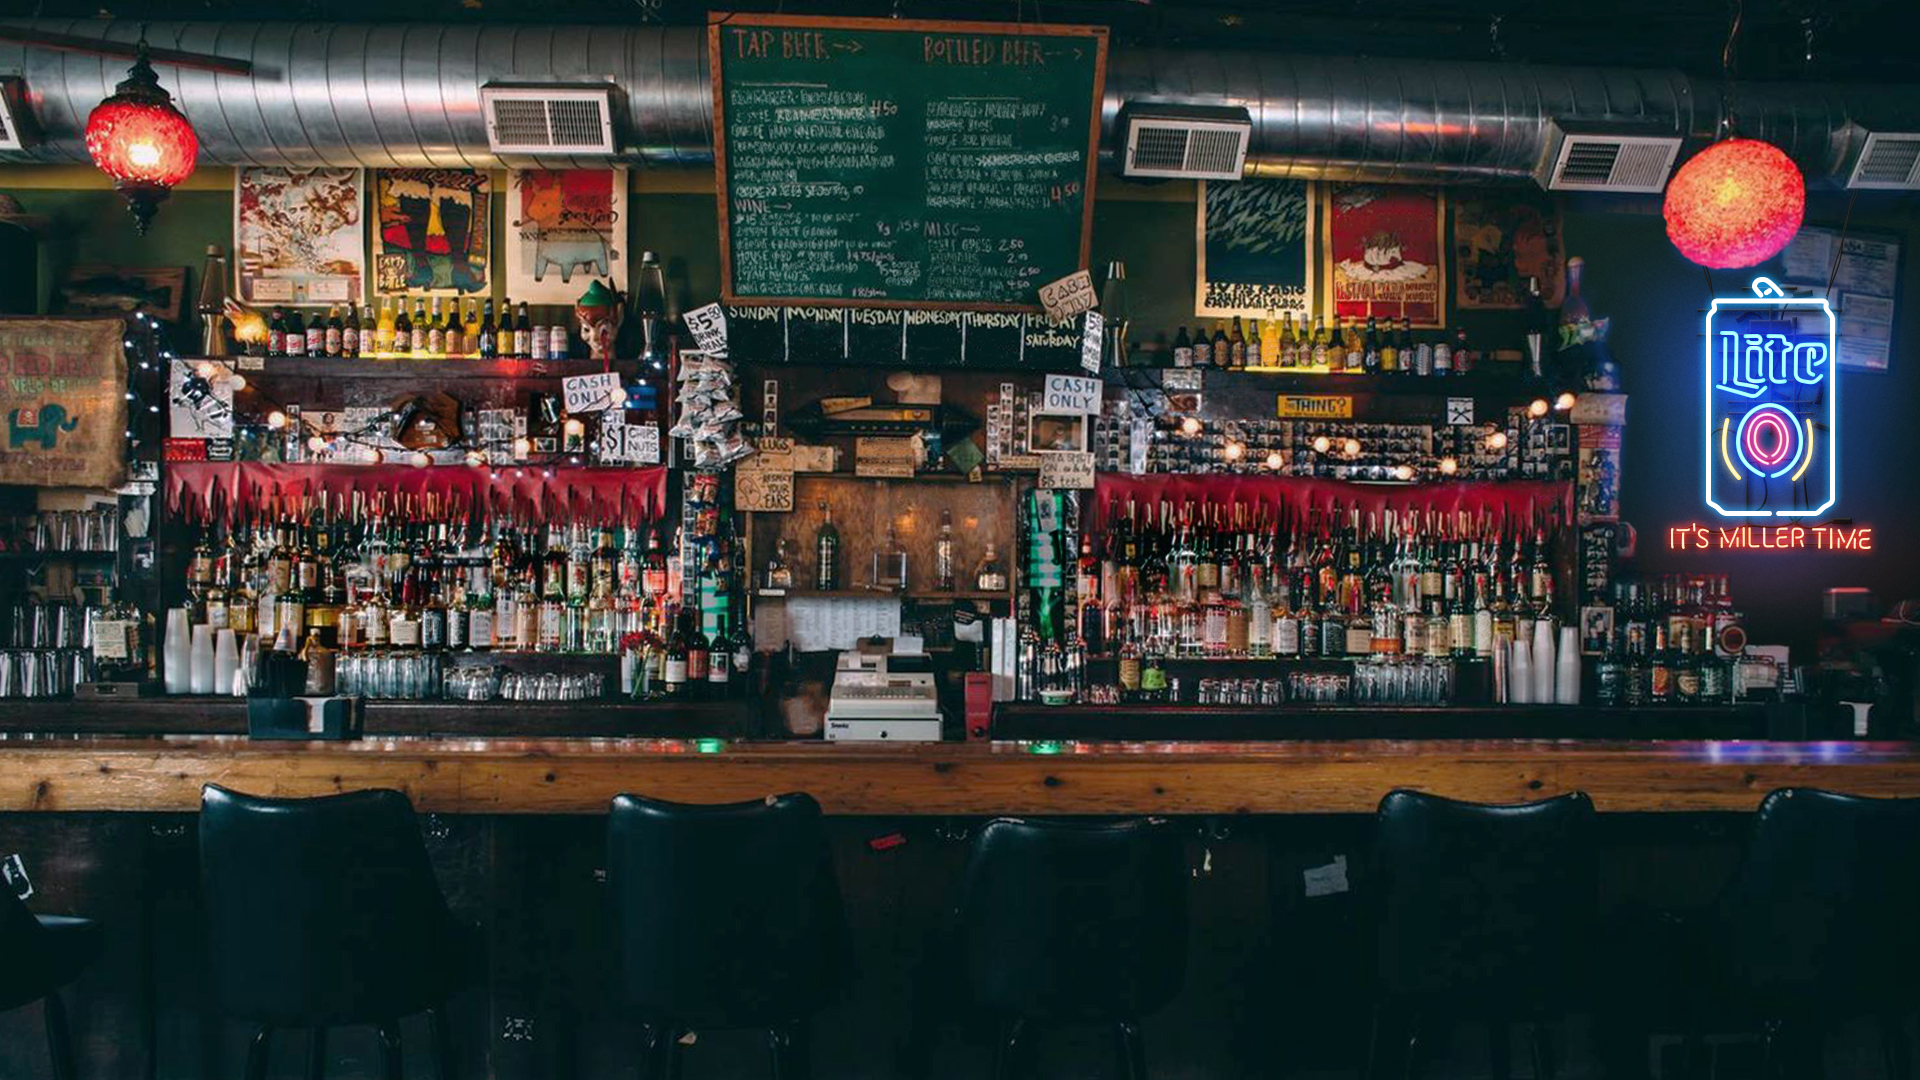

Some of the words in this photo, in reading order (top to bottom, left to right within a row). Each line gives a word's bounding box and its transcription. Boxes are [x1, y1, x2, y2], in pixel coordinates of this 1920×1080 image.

[733, 29, 774, 59] TAP
[782, 31, 829, 60] BEER
[923, 35, 991, 64] BOTTLED
[734, 199, 771, 214] WINE
[923, 220, 960, 237] MISC
[729, 305, 781, 324] SUNDAY
[787, 305, 844, 325] MONDAY
[850, 307, 902, 326] TUESDAY
[907, 310, 961, 328] WEDNESDAY
[965, 310, 1021, 329] THURSDAY
[694, 326, 722, 343] DRINK
[1025, 333, 1080, 349] SATURDAY
[700, 336, 728, 351] DEALS
[1716, 330, 1828, 399] Lite
[566, 374, 611, 391] CASH
[1051, 378, 1096, 393] CASH
[1049, 393, 1094, 409] ONLY
[606, 424, 625, 456] $1
[628, 427, 658, 440] CHIPS
[628, 441, 658, 453] NUTS
[1043, 463, 1058, 472] ON
[768, 484, 789, 494] YOUR
[764, 494, 791, 509] EARS
[1670, 522, 1710, 550] IT'S
[1720, 526, 1805, 549] MILLER
[1811, 527, 1872, 550] TIME
